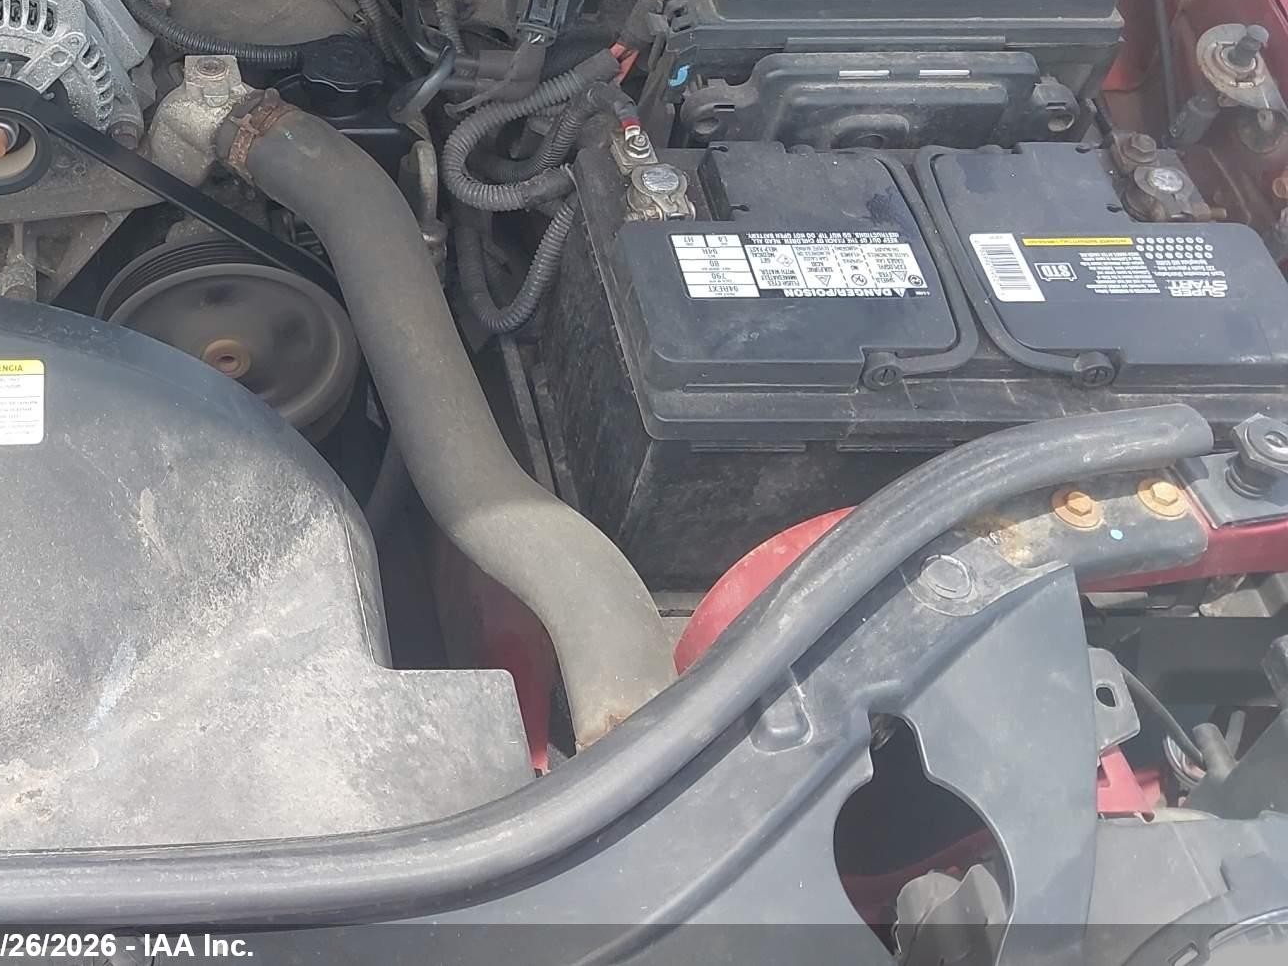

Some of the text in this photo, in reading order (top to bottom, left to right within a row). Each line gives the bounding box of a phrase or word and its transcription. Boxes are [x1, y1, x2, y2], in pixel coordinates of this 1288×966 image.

[1040, 264, 1072, 278] STD
[1167, 280, 1228, 291] START
[783, 288, 893, 297] DANGER/POISON
[1170, 289, 1226, 298] SUPER
